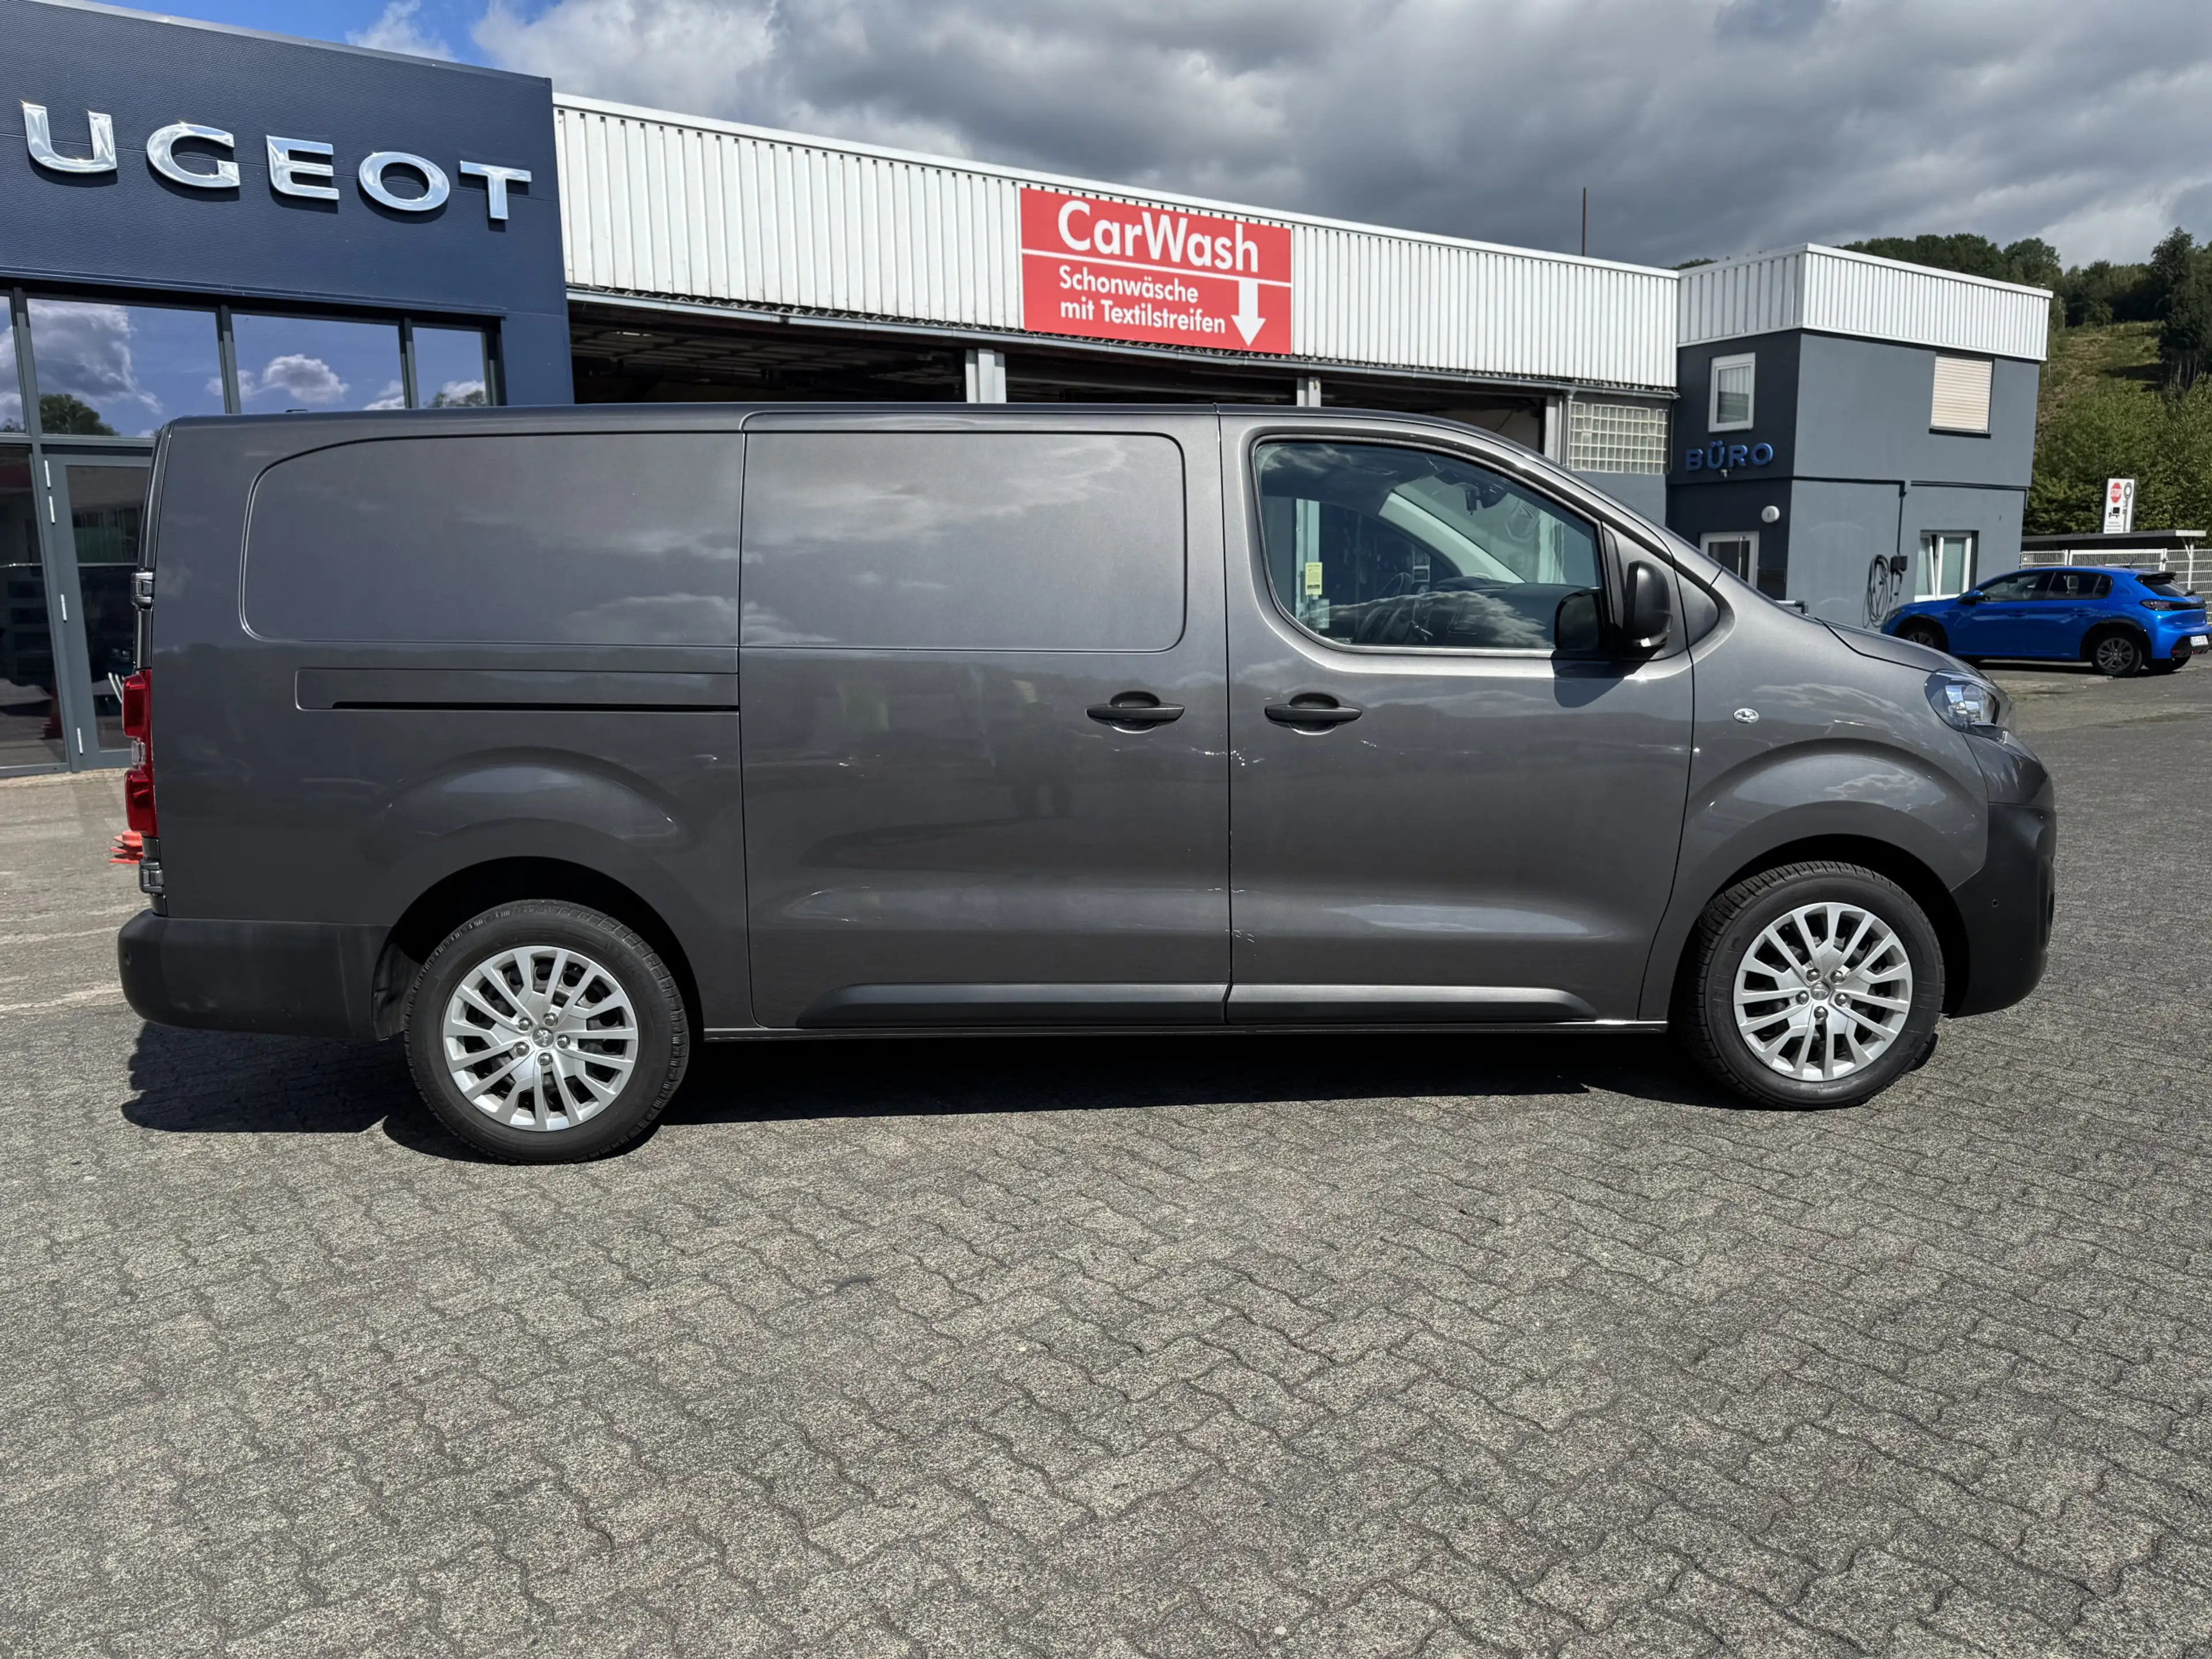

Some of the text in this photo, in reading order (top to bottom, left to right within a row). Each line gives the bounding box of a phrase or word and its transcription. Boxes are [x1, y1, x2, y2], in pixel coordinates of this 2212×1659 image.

[21, 100, 532, 220] UGEOT
[1058, 200, 1259, 272] CarWash
[1059, 265, 1199, 304] Schonwäsche
[1060, 296, 1225, 334] mit Textilstreifen
[1685, 440, 1774, 471] BÜRO
